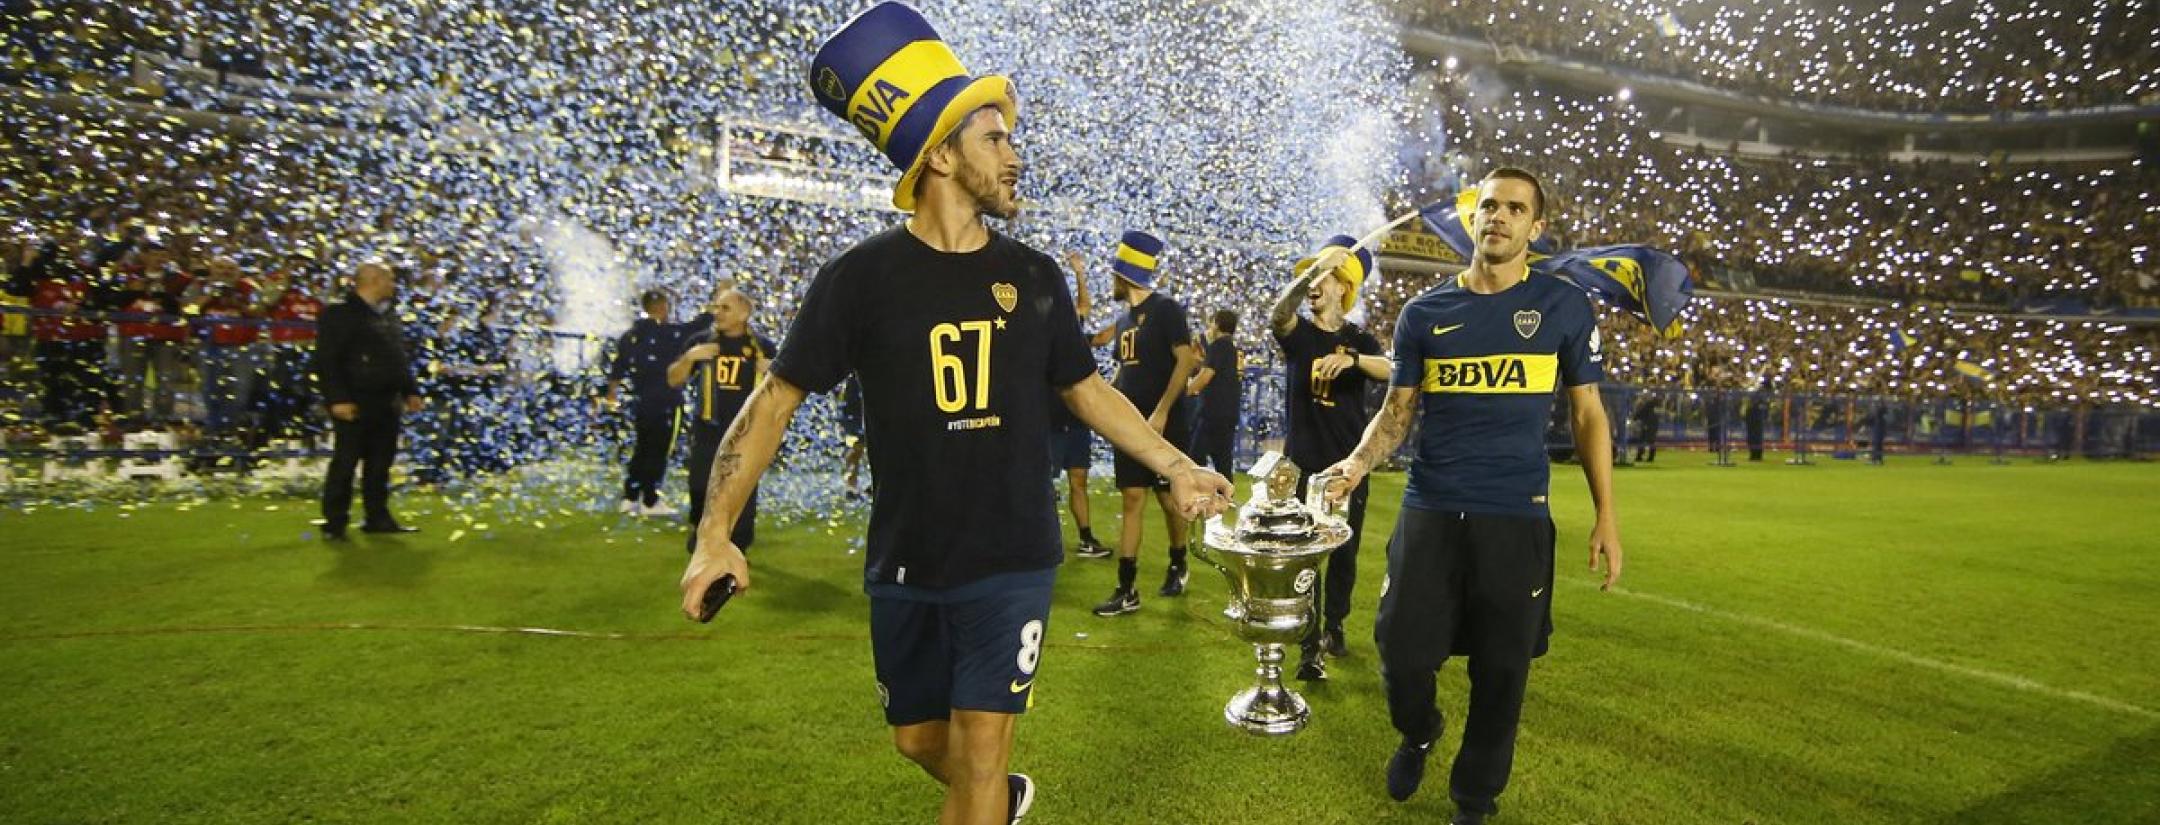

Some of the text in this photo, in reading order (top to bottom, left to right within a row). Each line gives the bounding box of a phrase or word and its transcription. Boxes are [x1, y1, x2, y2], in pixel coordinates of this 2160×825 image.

[717, 356, 740, 384] 67
[929, 320, 993, 413] 67
[1438, 358, 1527, 388] BBVA
[1017, 619, 1043, 674] 8
